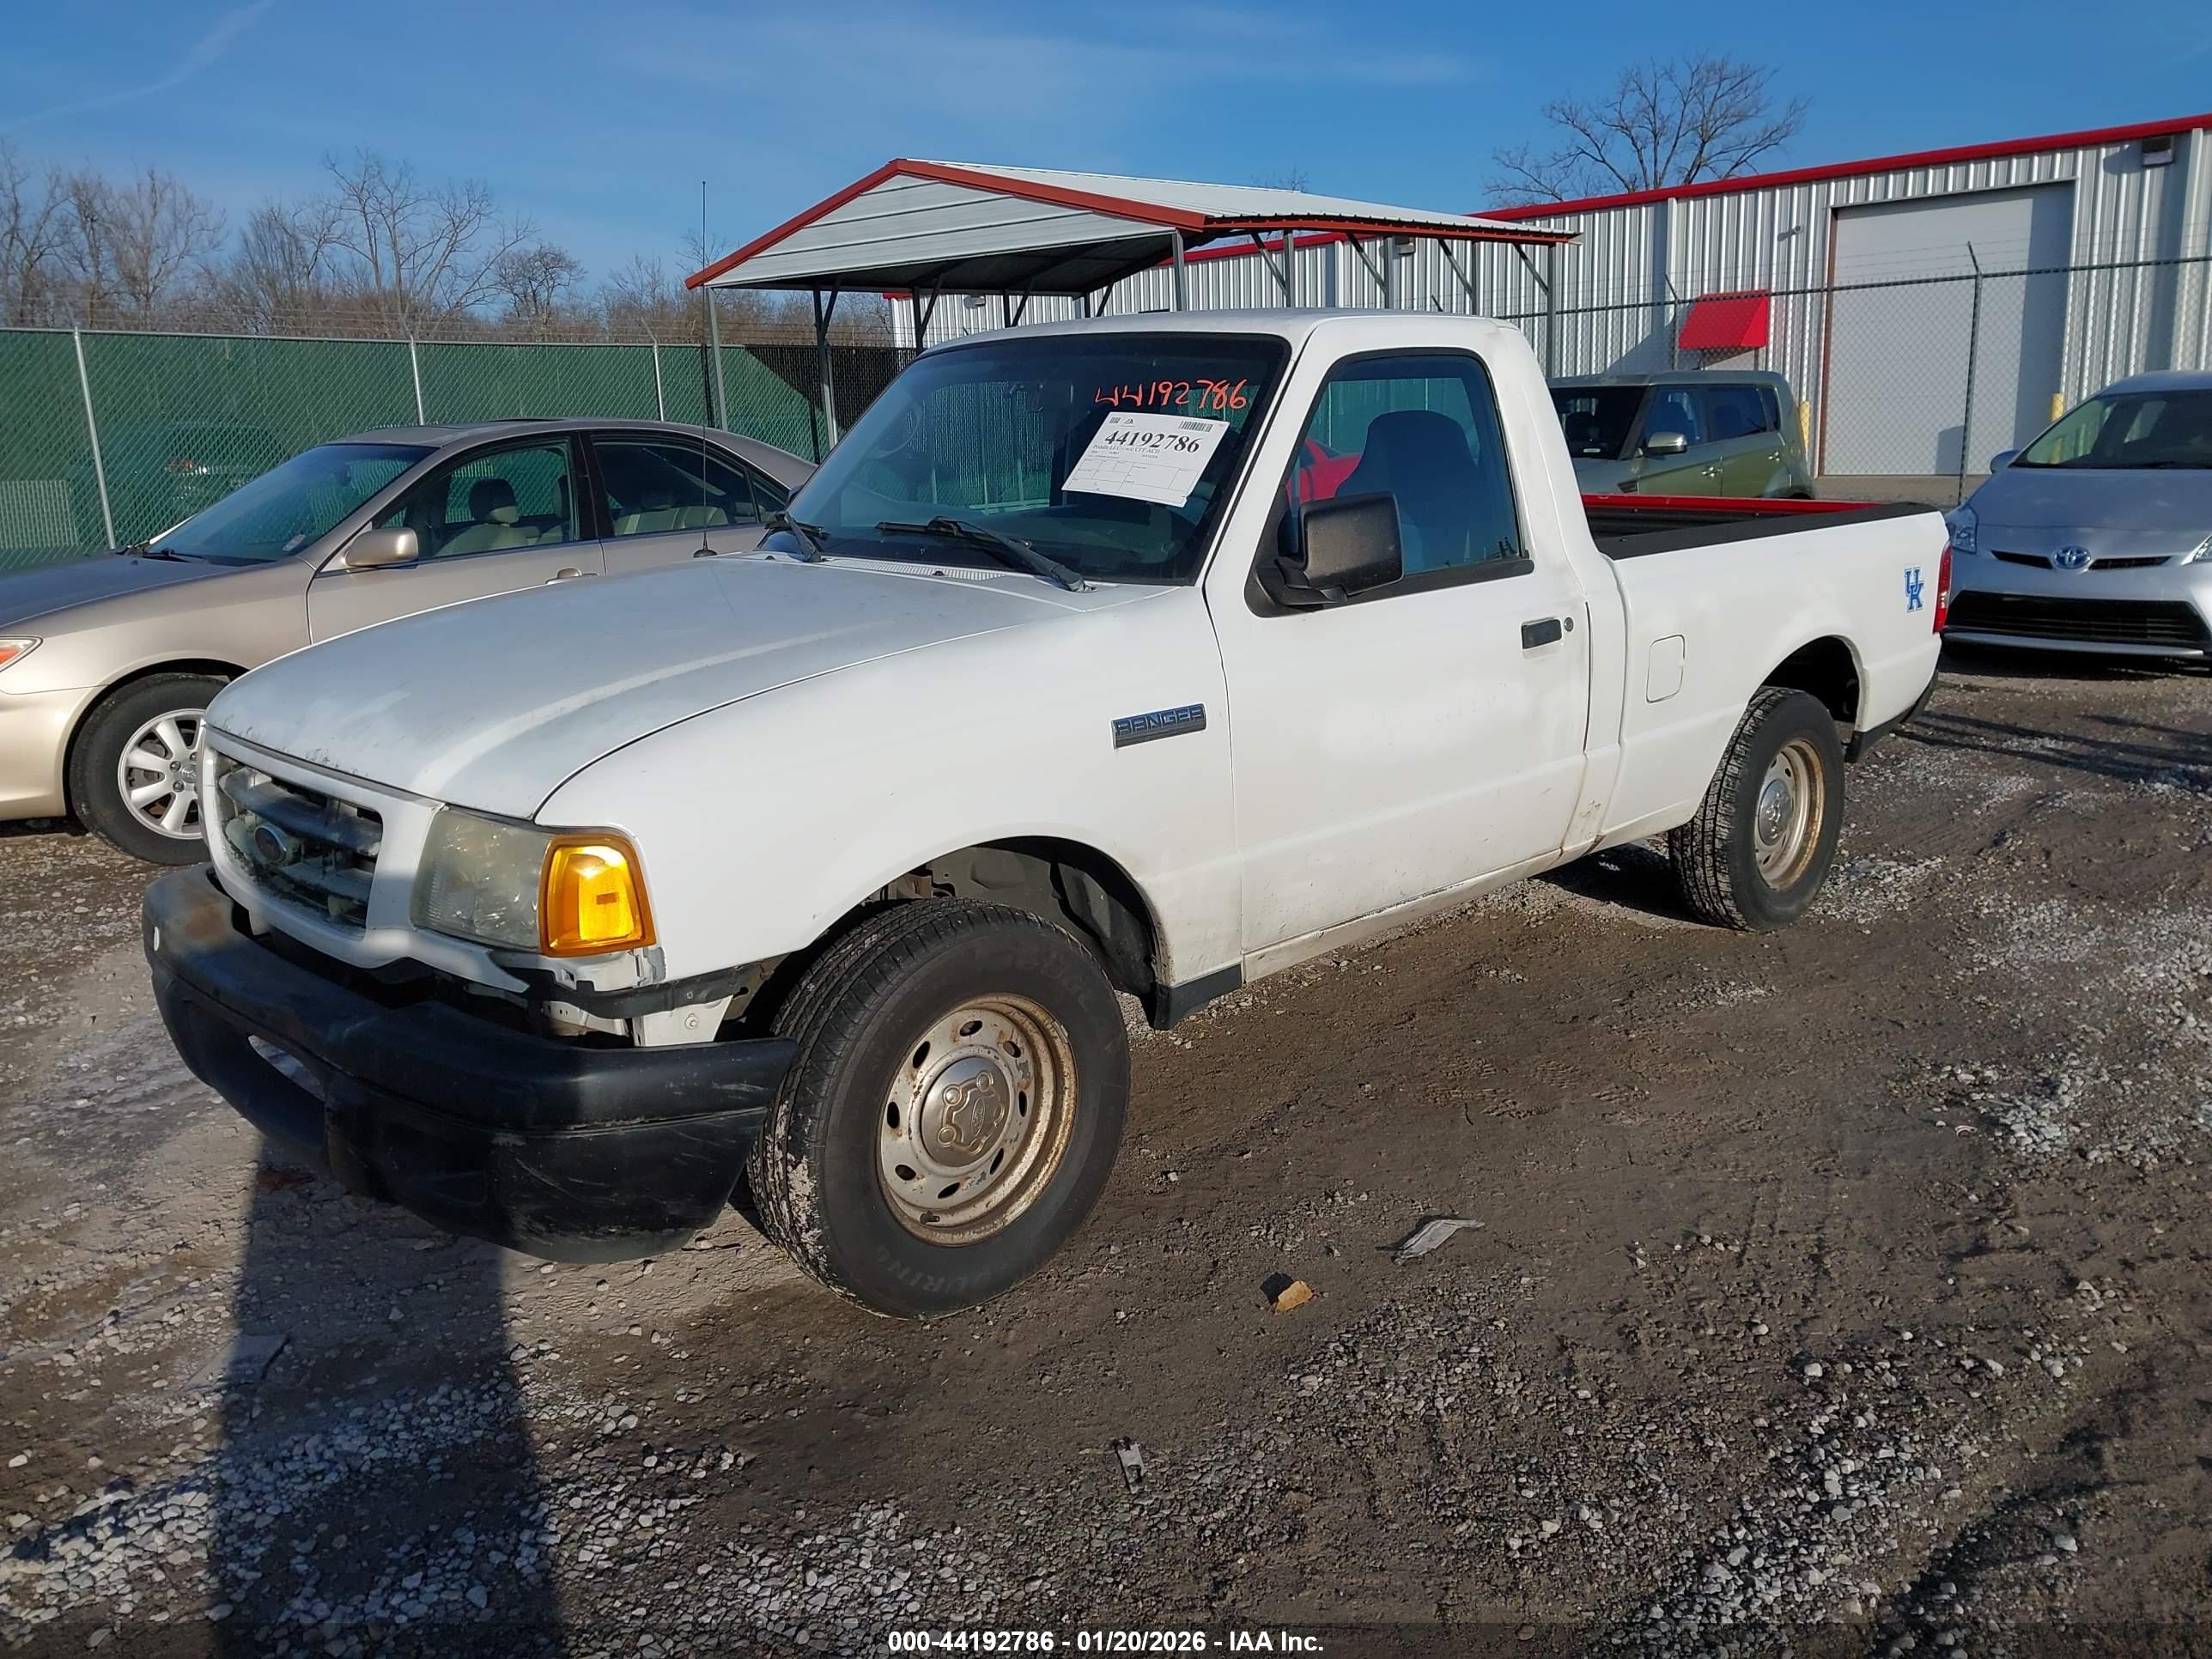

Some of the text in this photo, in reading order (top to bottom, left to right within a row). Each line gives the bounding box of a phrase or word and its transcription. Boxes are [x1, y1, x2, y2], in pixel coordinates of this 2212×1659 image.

[1104, 430, 1203, 453] 44192786
[1905, 567, 1924, 612] UK
[1115, 706, 1204, 737] RANGER
